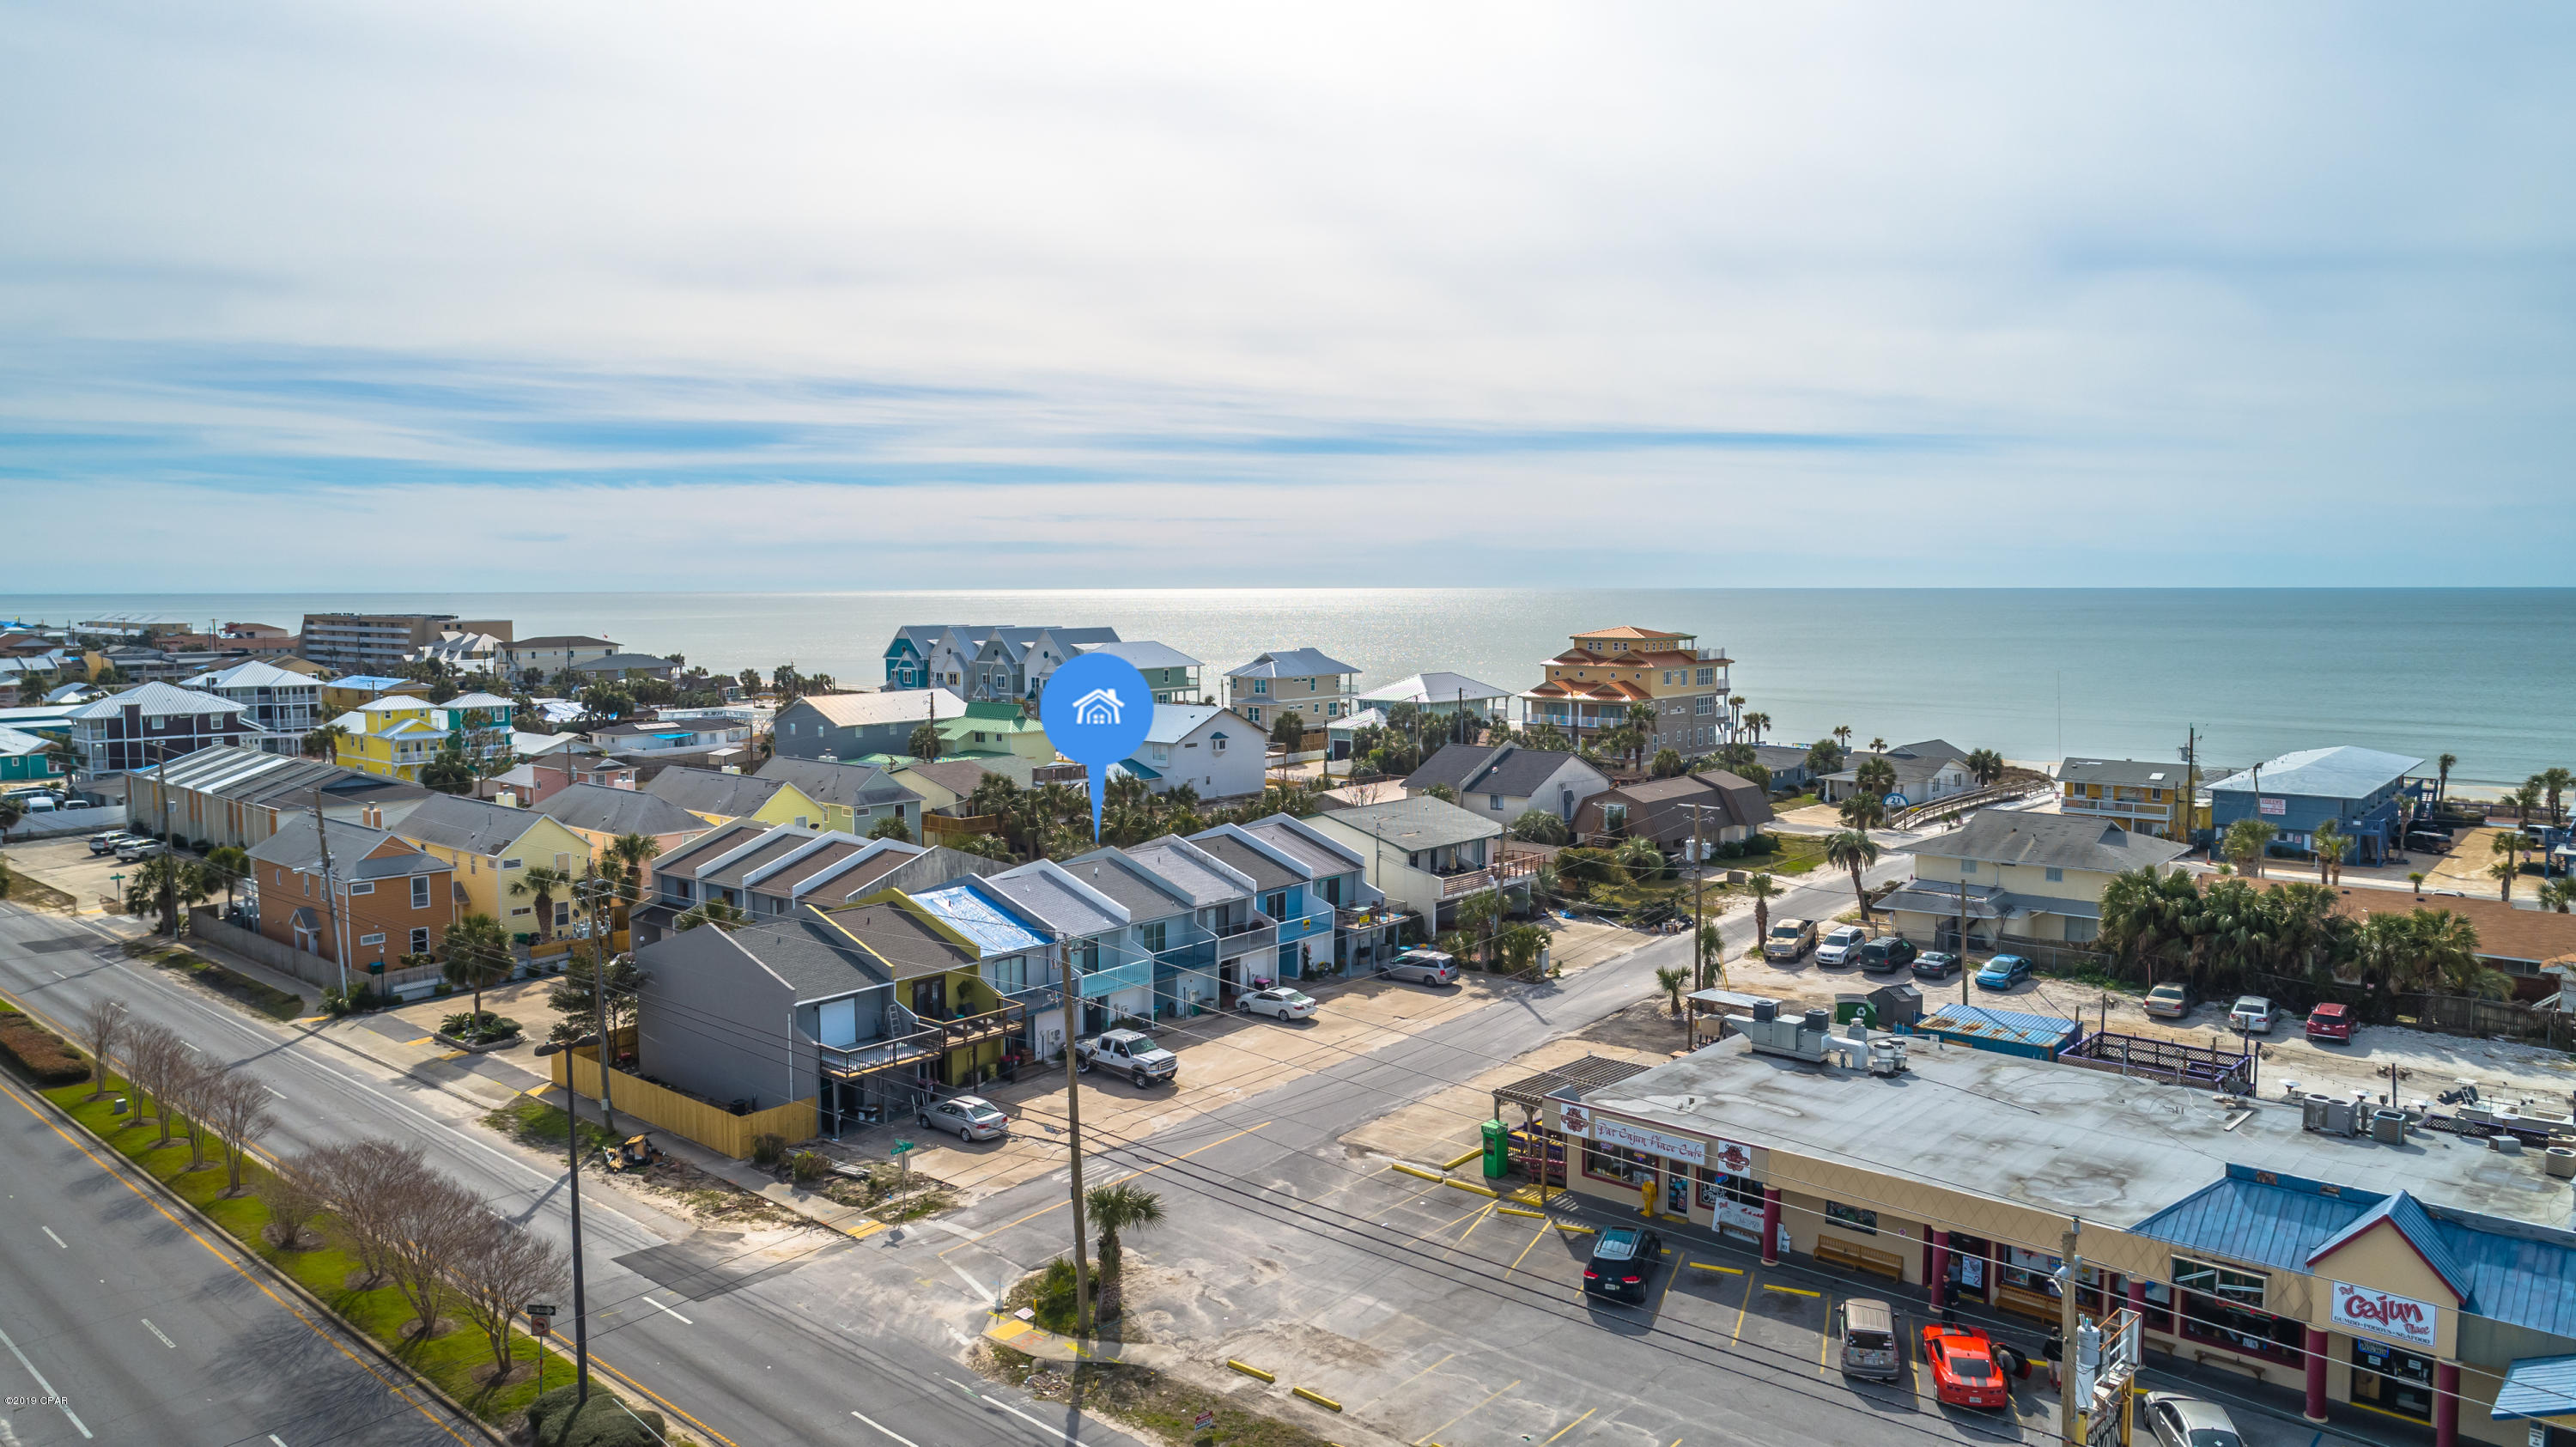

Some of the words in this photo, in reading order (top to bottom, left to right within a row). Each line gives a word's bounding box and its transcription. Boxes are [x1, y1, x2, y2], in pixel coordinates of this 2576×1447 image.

[1619, 1128, 1647, 1147] Cajun
[1649, 1134, 1675, 1152] Place
[1679, 1144, 1702, 1160] Cafe
[2344, 1294, 2424, 1327] Cajun
[2334, 1316, 2360, 1327] GUMBO
[2396, 1332, 2430, 1344] SEAFOOD
[2403, 1322, 2431, 1335] Place
